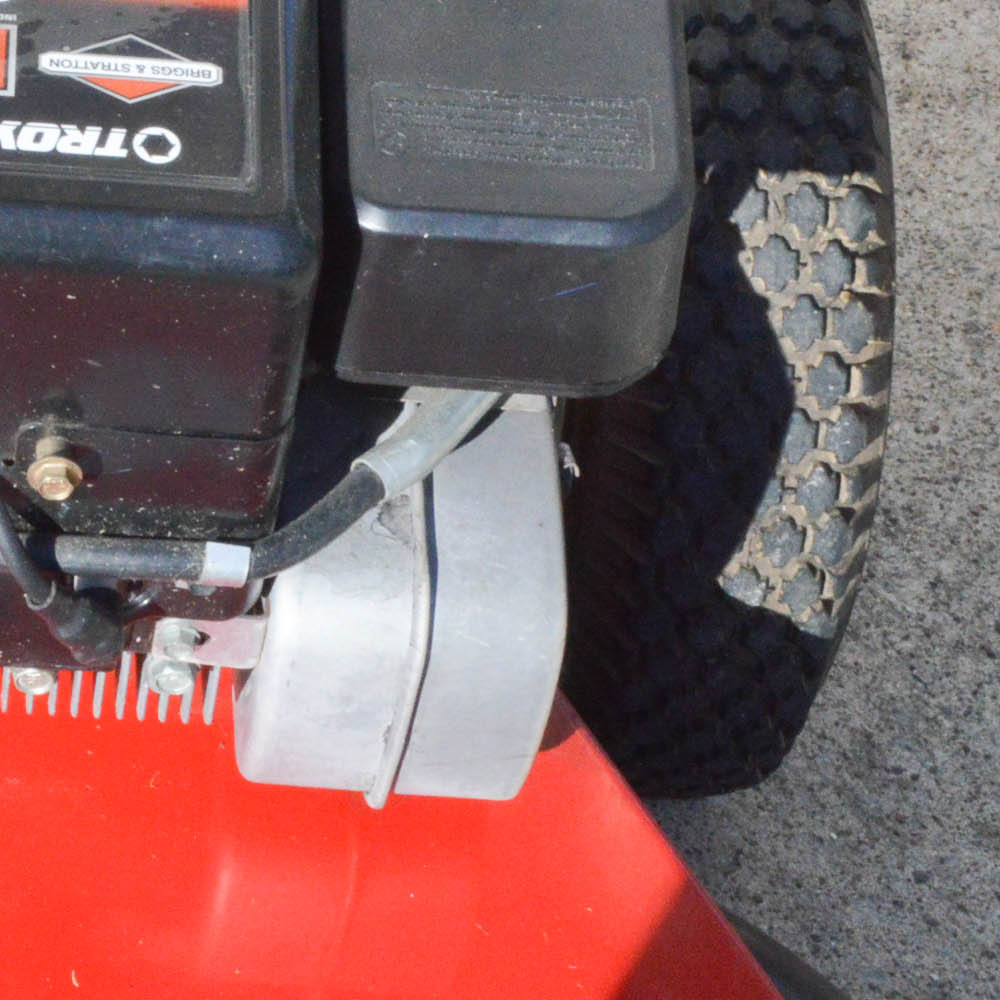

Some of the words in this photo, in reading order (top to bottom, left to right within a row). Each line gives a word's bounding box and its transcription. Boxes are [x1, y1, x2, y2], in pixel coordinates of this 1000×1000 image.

[49, 58, 133, 73] STRATTON
[136, 64, 146, 74] &
[150, 65, 212, 80] BRIGGS
